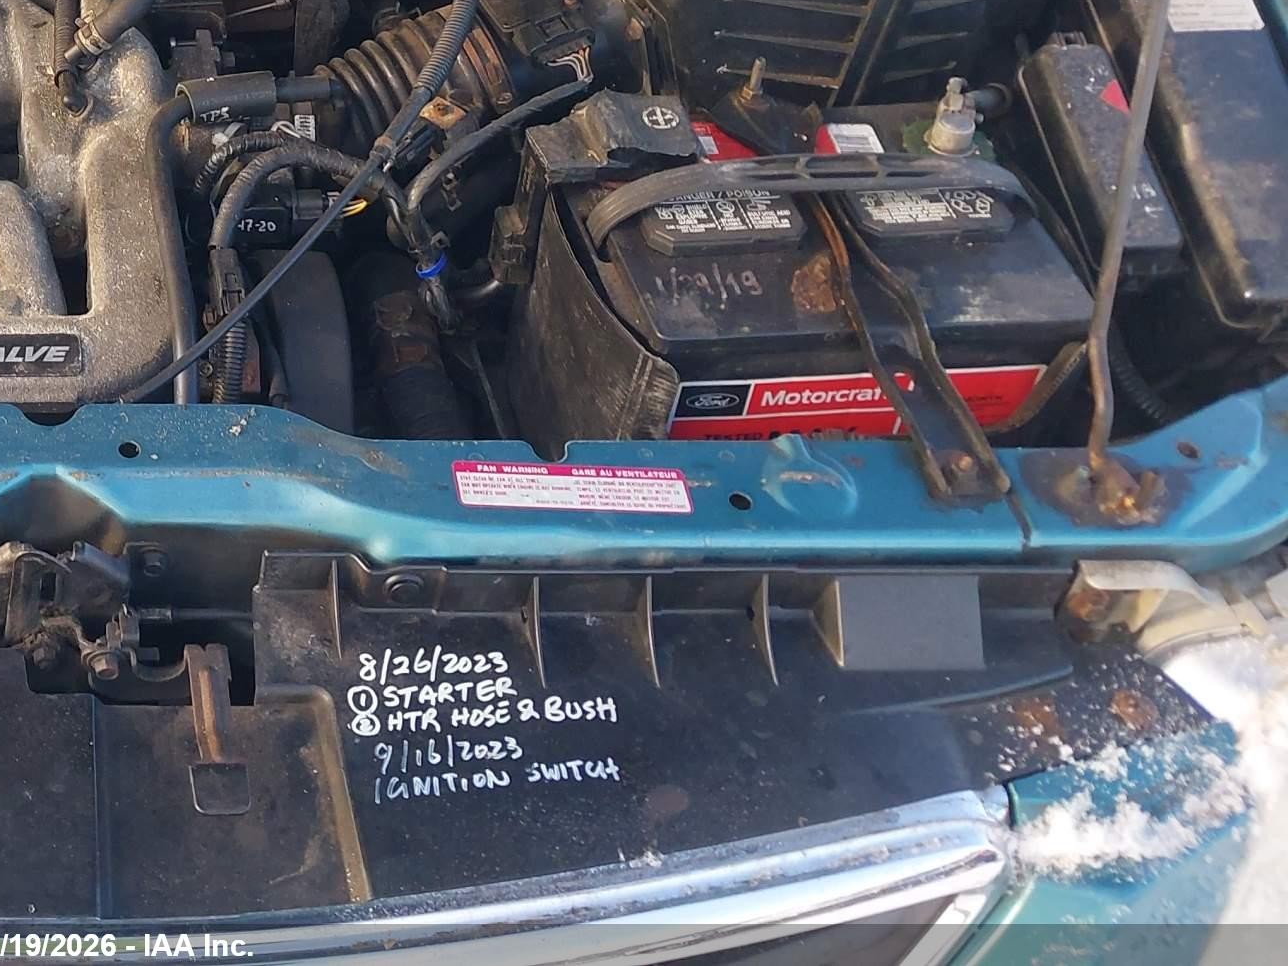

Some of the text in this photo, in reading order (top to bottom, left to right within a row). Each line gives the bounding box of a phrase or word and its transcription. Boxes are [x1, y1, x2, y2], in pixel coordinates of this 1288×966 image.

[476, 464, 549, 474] FAN WARNING
[571, 468, 678, 479] GARE AU VENTILATEUR
[359, 645, 509, 684] 8/26/2023
[383, 676, 518, 709] STARTER
[387, 709, 441, 733] HTR
[451, 701, 511, 729] HOSE
[544, 696, 617, 723] BUSH
[374, 735, 523, 775] 9/16/2023
[374, 757, 622, 804] IGNITION SWITCH
